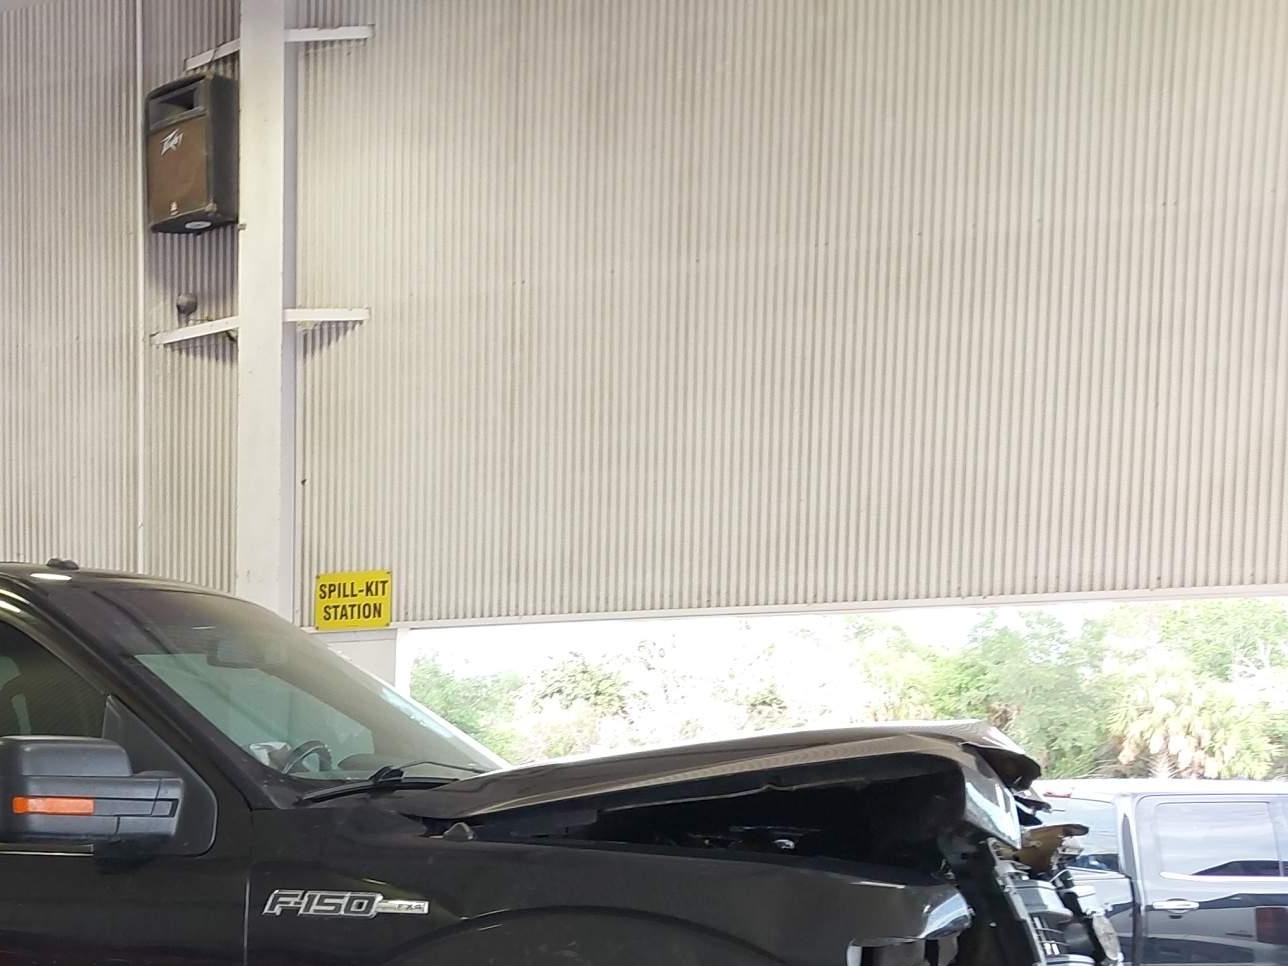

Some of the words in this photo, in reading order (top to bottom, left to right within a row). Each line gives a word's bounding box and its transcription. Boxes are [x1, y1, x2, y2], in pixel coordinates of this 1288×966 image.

[319, 580, 389, 599] SPILL-KIT
[323, 603, 382, 621] STATION
[263, 889, 383, 918] F-150
